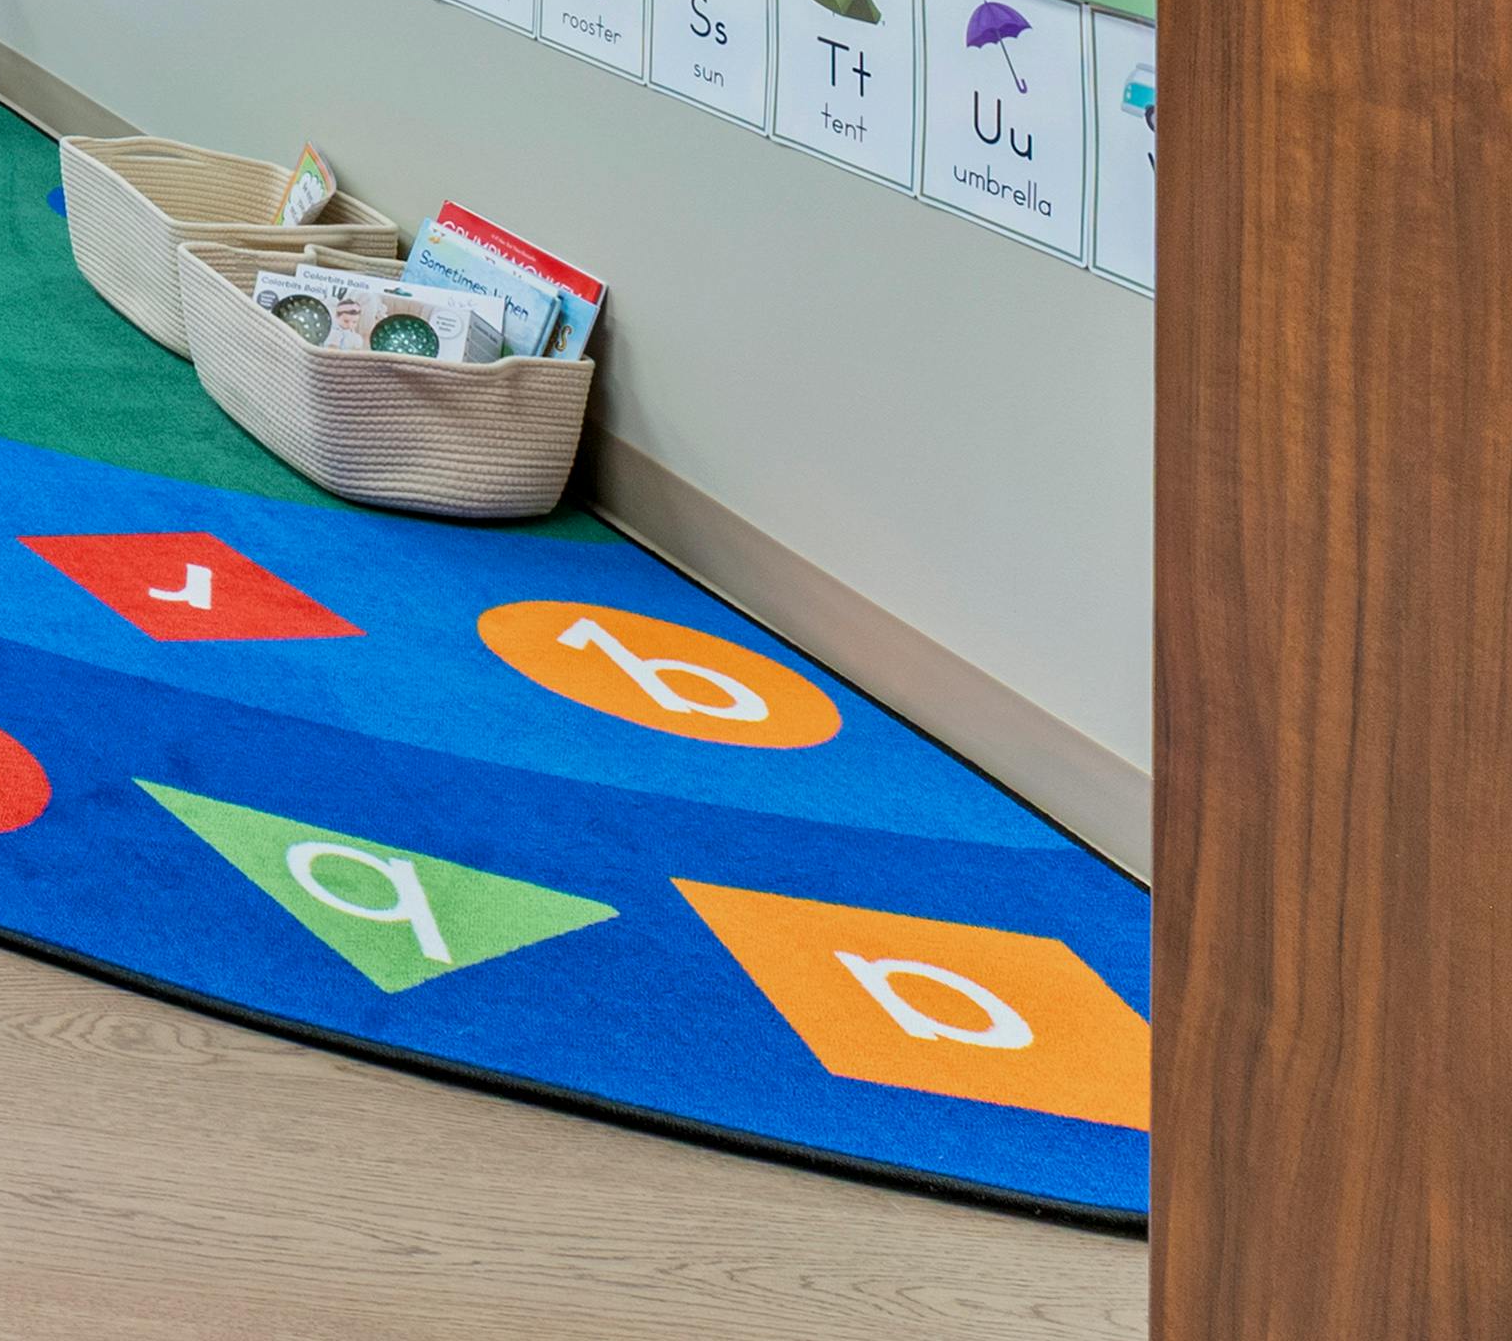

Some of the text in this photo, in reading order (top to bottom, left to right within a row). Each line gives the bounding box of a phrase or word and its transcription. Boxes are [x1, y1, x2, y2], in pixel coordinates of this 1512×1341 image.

[562, 11, 622, 46] rooster
[694, 63, 725, 88] sun
[817, 36, 872, 97] Tt
[821, 102, 868, 143] tent
[974, 90, 1033, 161] Uu
[953, 164, 1053, 218] umbrella
[303, 270, 344, 285] Colorbits
[419, 249, 487, 296] Sometimes
